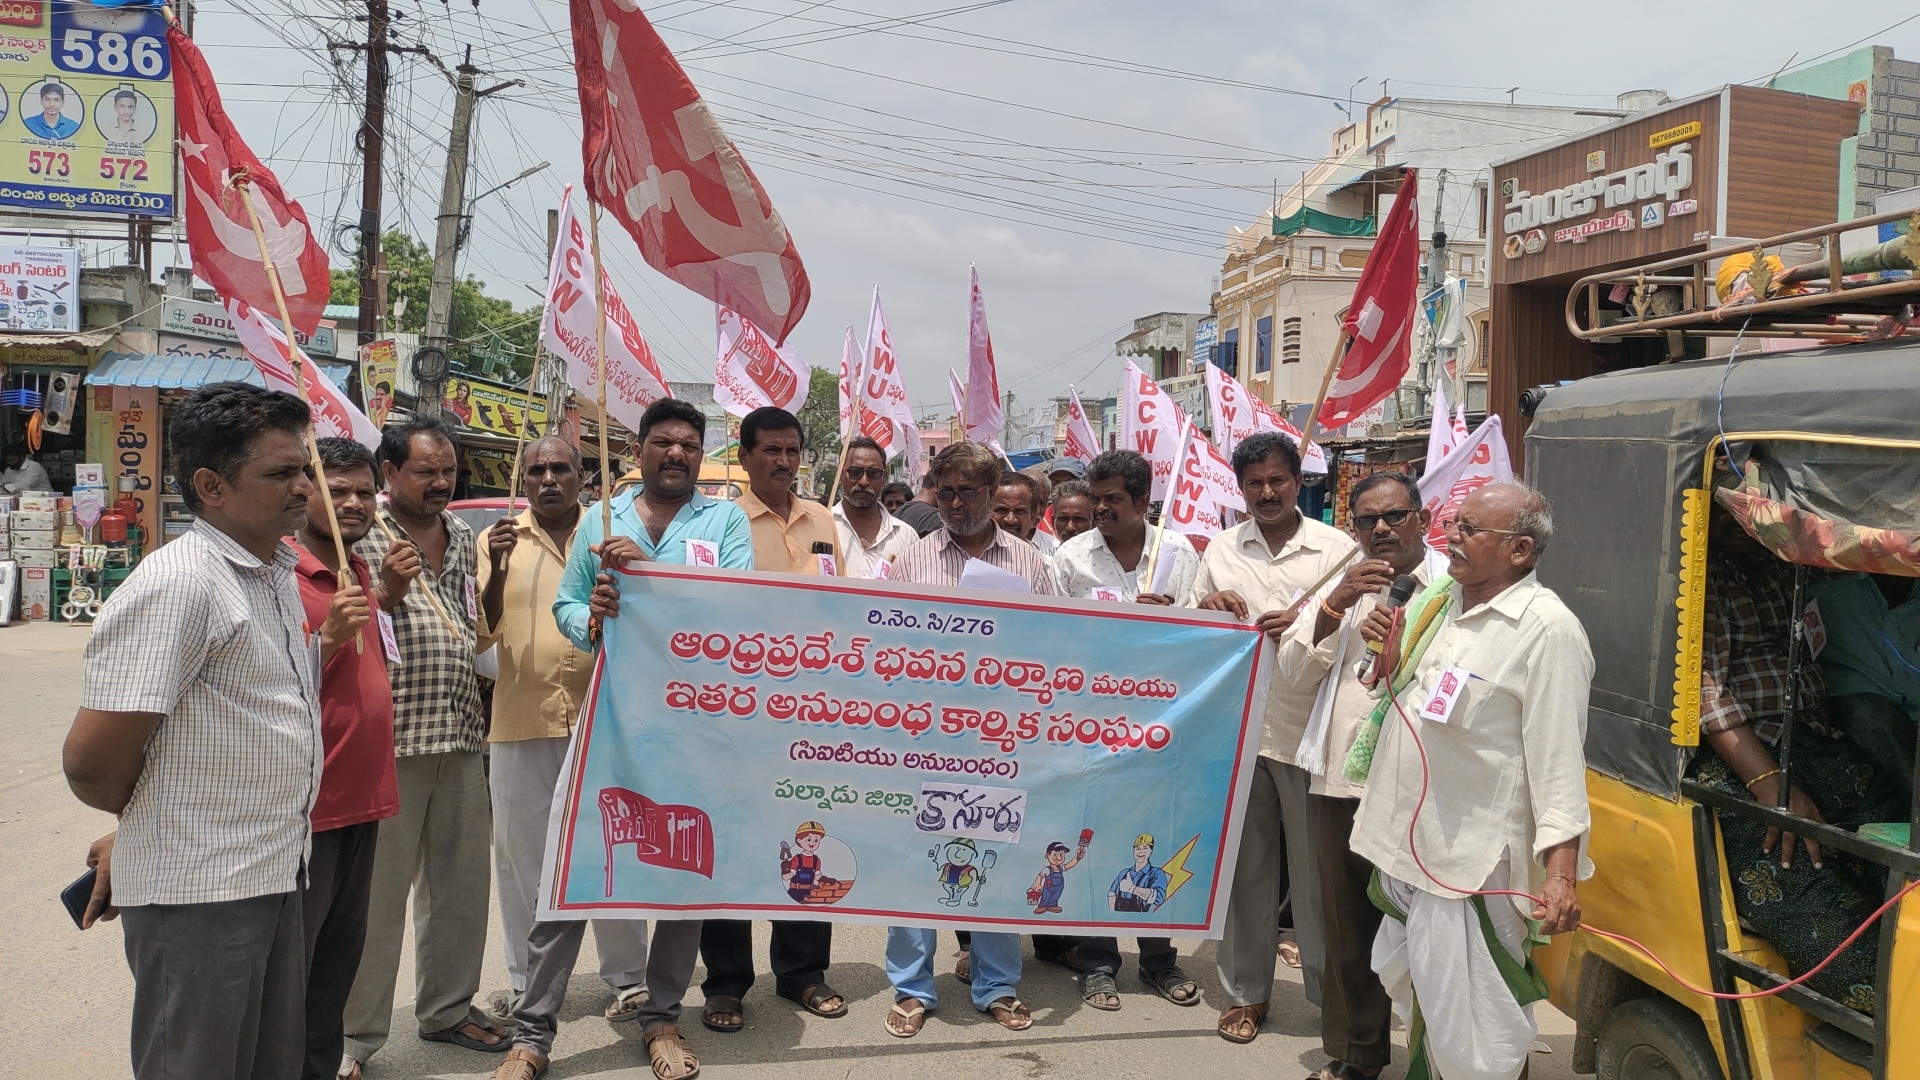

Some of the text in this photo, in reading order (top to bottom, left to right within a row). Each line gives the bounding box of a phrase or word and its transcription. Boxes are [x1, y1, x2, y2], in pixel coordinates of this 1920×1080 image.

[62, 29, 164, 77] 586
[28, 150, 71, 177] 573
[100, 157, 149, 182] 572
[90, 191, 165, 209] విజయం
[1668, 200, 1695, 217] A/C
[472, 347, 512, 364] MEDICAL
[510, 398, 545, 411] walkate
[867, 608, 995, 636] రి.నెం. సి/276
[670, 631, 1178, 705] ఆంధ్రప్రదేశ్ భవన నిర్మాణ మరియు
[666, 681, 1171, 753] ఇతర అనుబంధ కార్మిక సంఘం
[789, 739, 1019, 780] (సిఐటియు అనుబంధం)
[774, 778, 919, 815] పల్నాడు జిల్లా,
